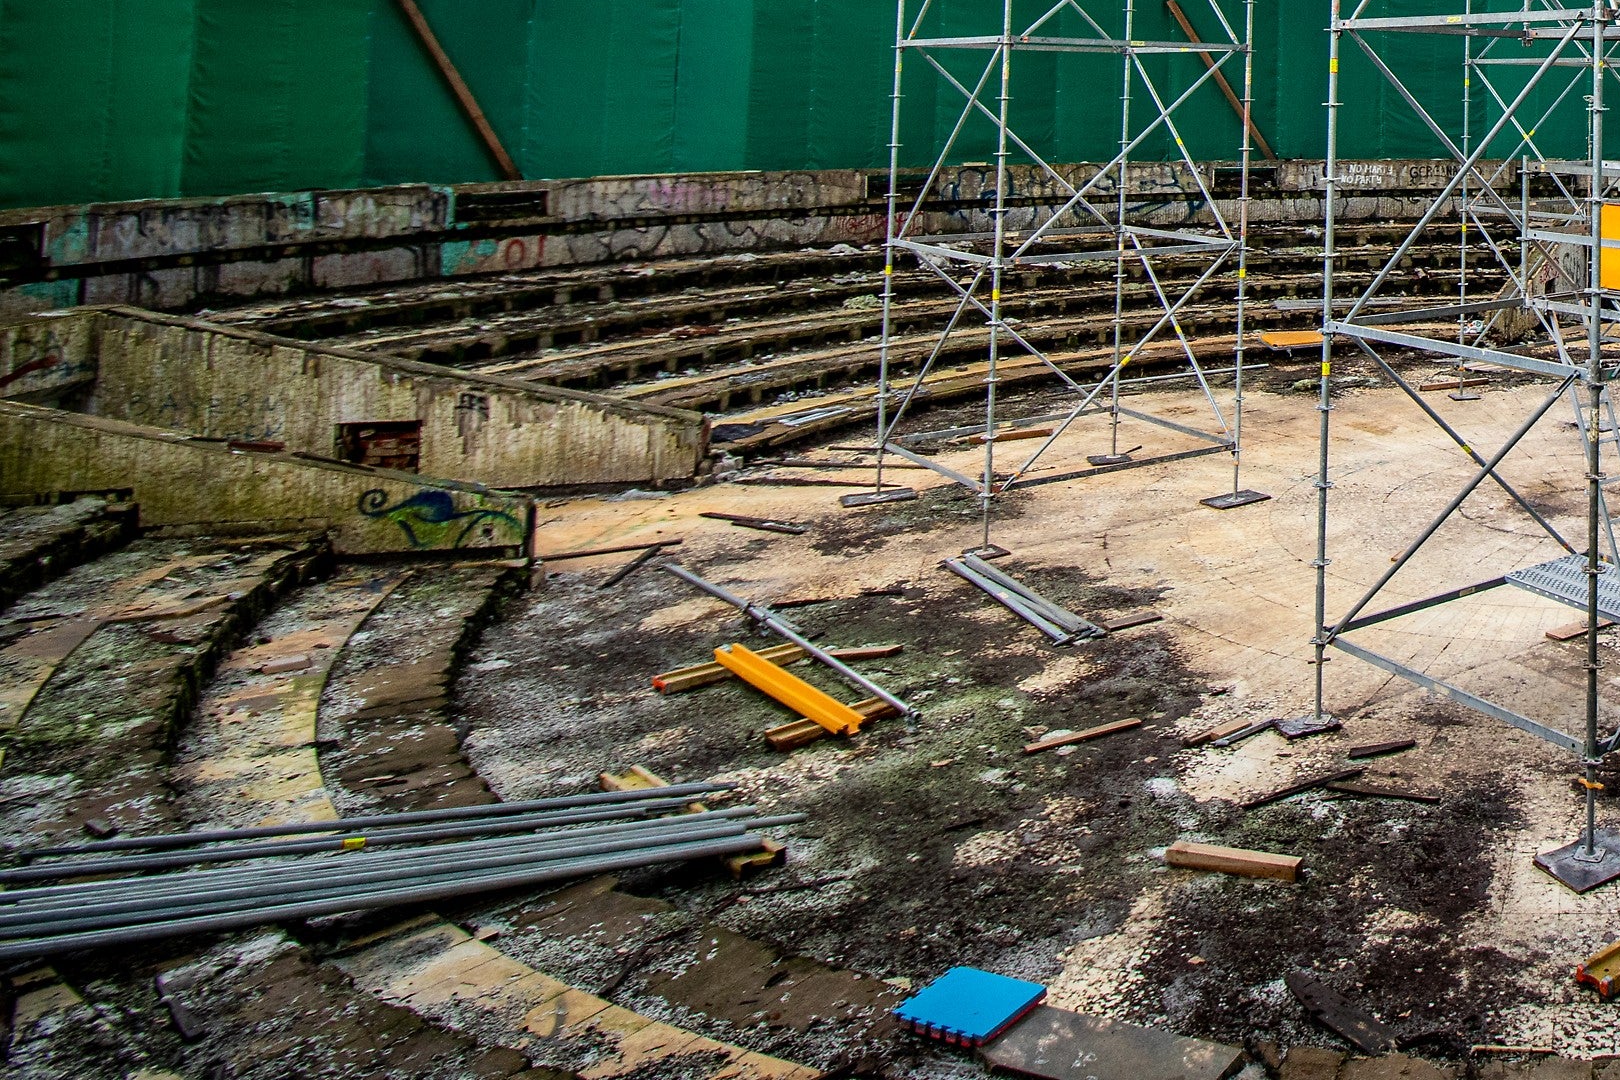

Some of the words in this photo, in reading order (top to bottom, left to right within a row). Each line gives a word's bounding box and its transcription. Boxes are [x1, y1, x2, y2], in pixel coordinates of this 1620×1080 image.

[1349, 164, 1363, 173] NO
[1341, 174, 1353, 184] NO
[1354, 175, 1382, 185] PARTY
